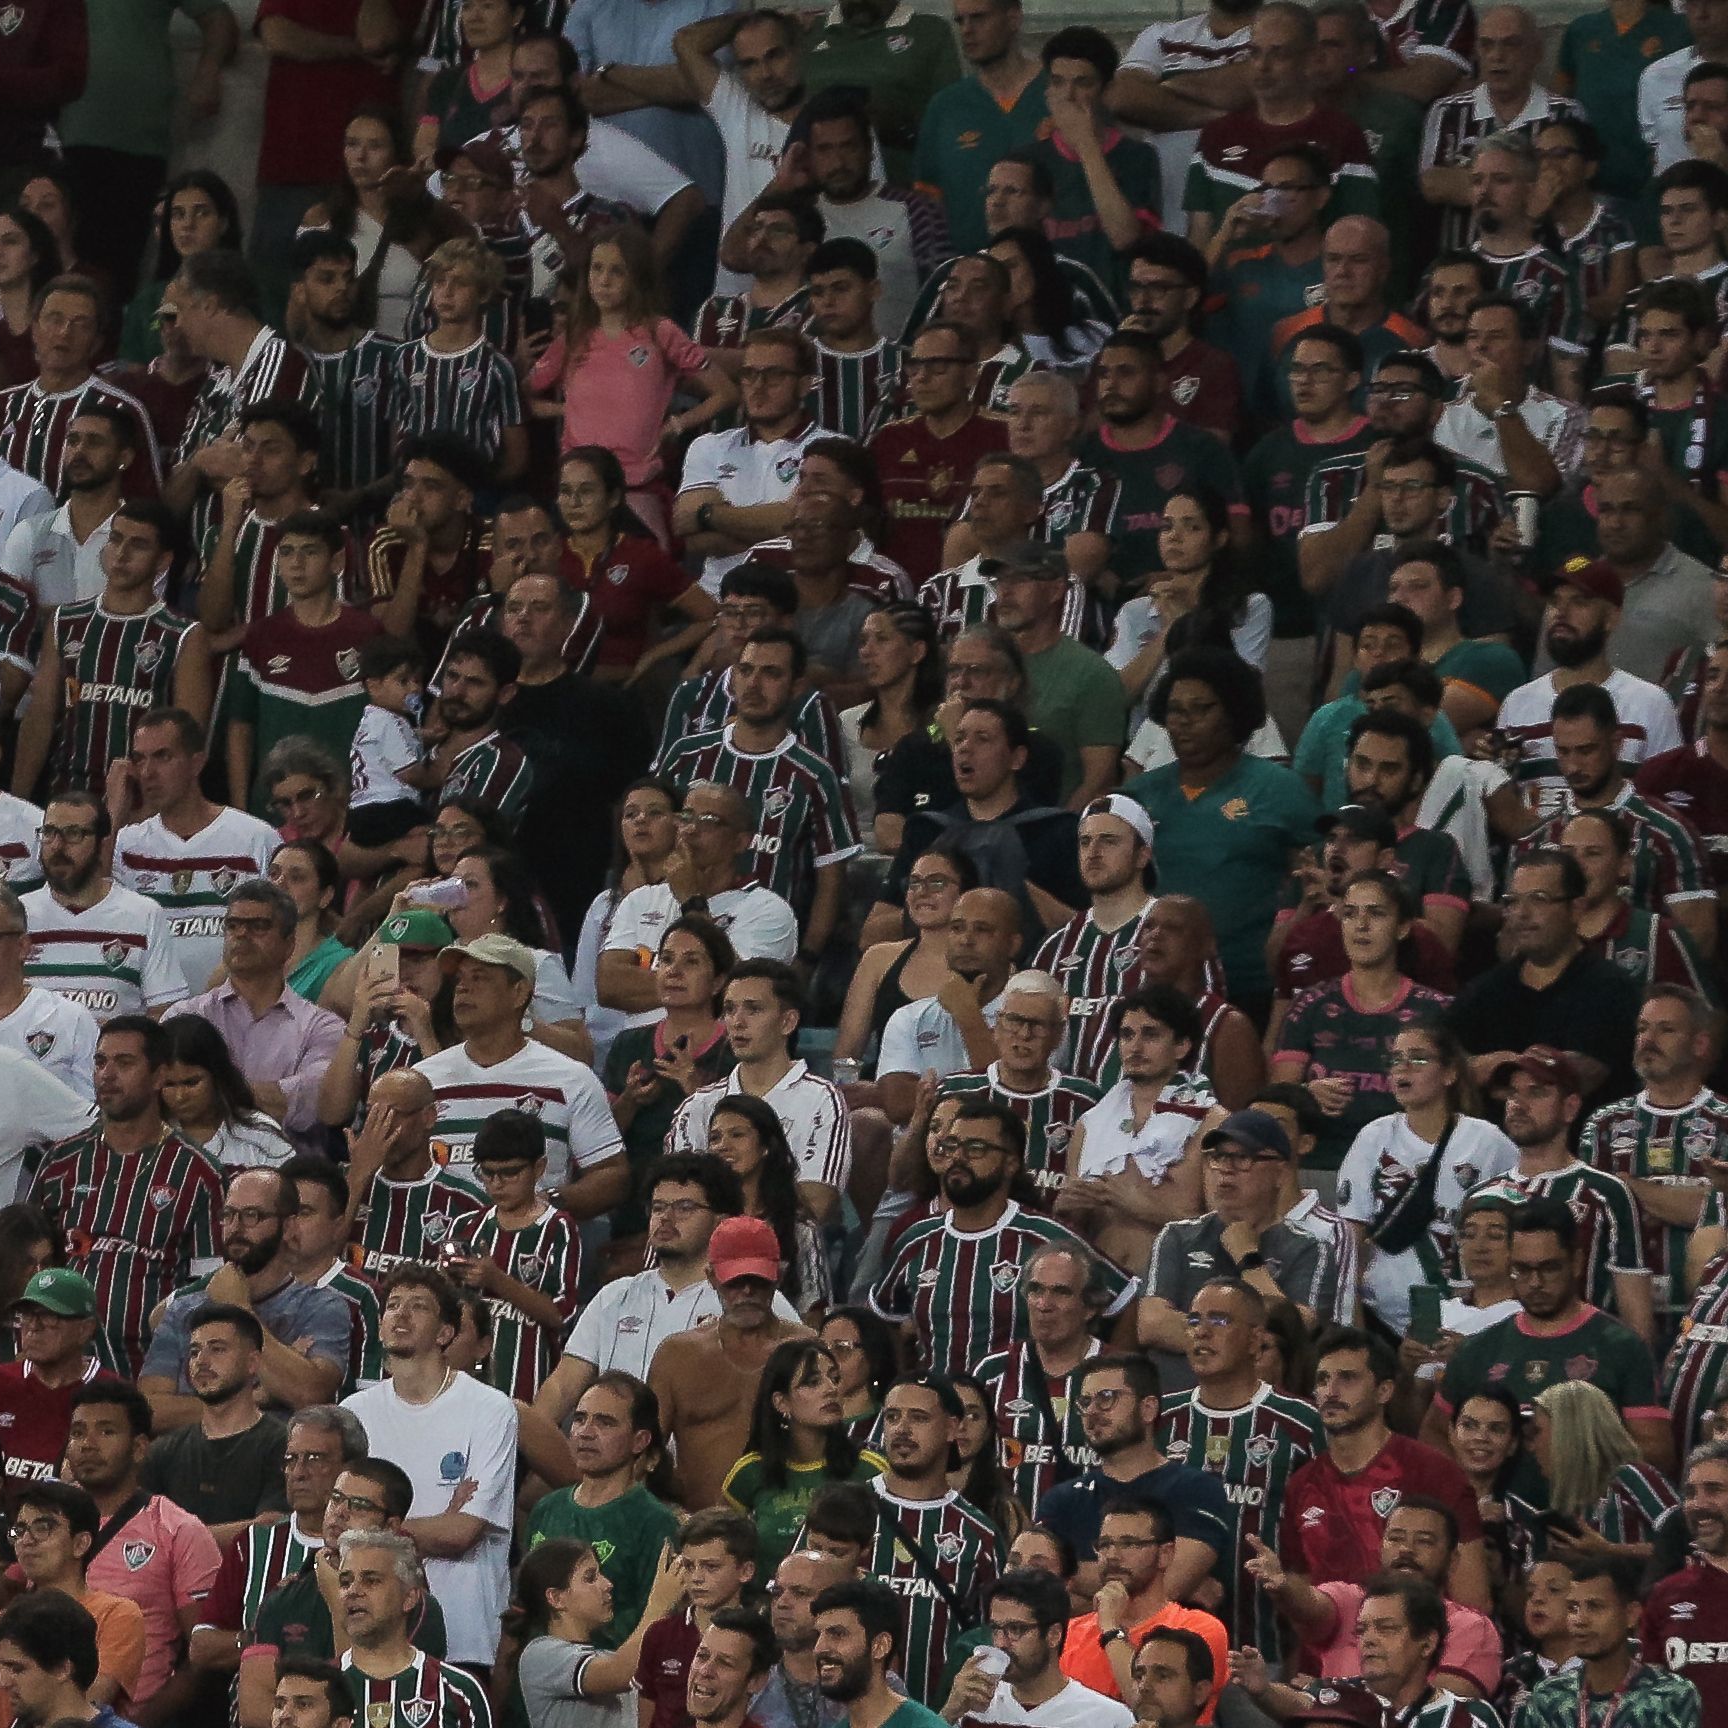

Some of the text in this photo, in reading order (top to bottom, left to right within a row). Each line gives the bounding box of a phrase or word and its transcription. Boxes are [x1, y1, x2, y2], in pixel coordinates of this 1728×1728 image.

[79, 683, 154, 709] BETANO
[167, 916, 226, 938] ETAN
[59, 990, 118, 1012] TANO
[1024, 1445, 1104, 1467] BEANO
[4, 1455, 56, 1481] BETA
